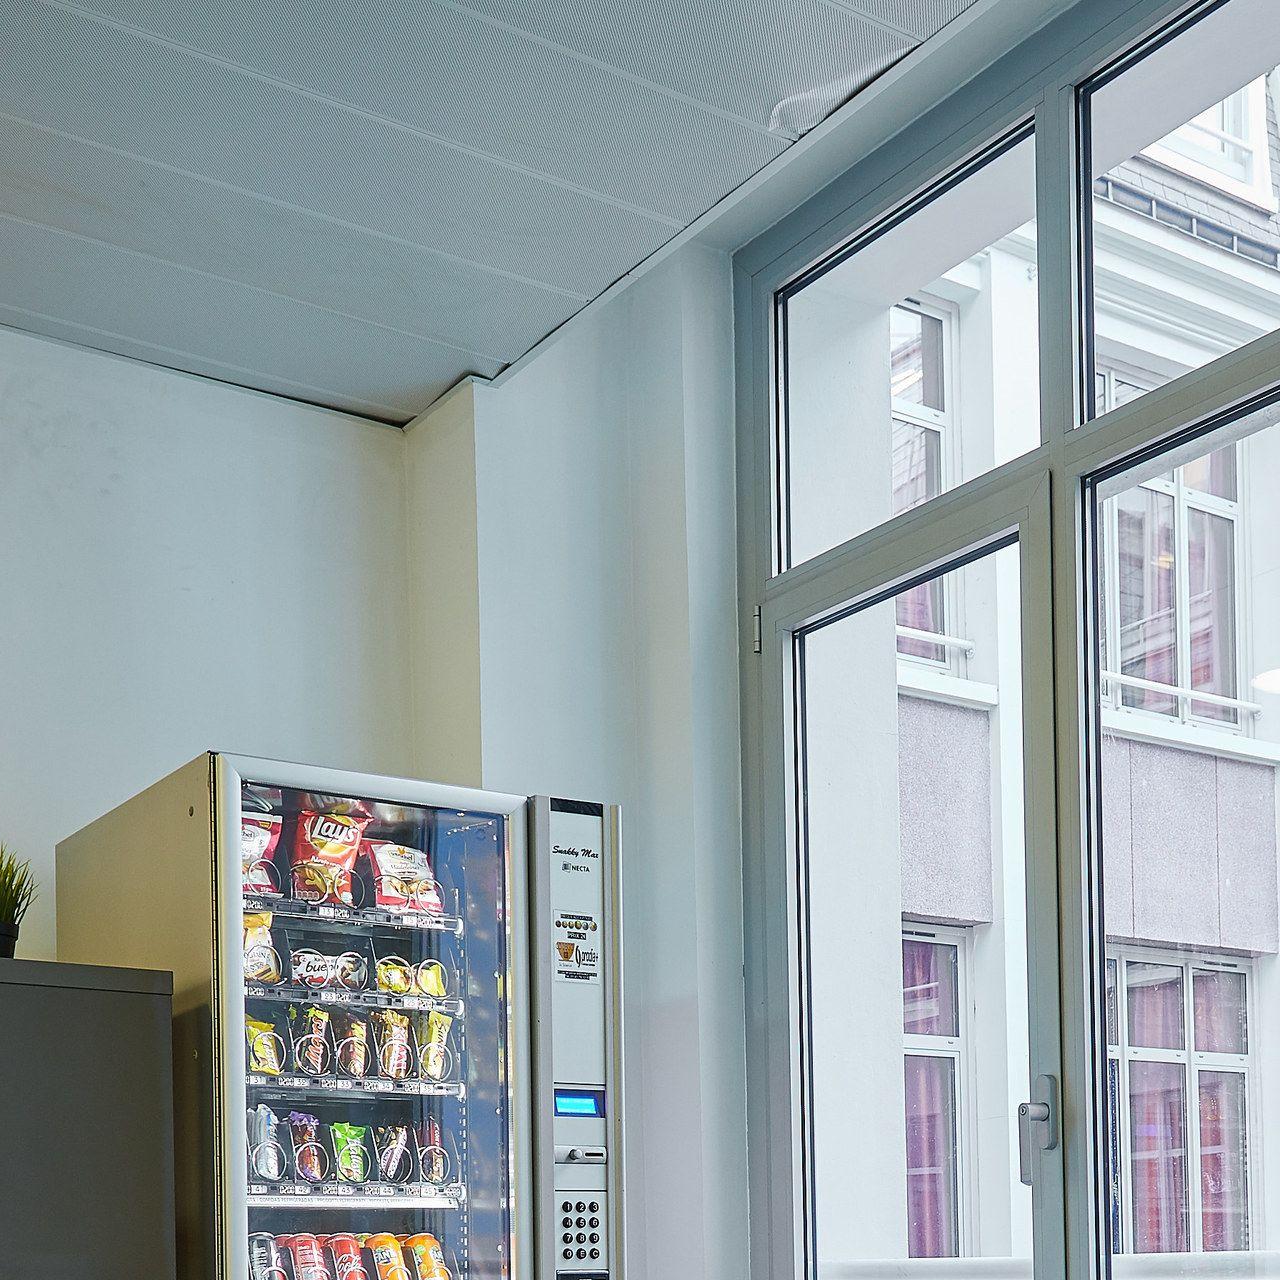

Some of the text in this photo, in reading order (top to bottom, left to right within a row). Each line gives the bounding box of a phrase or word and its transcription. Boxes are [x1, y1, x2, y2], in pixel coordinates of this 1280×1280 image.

[552, 845, 599, 859] Snakky Max
[571, 865, 590, 873] NECTA
